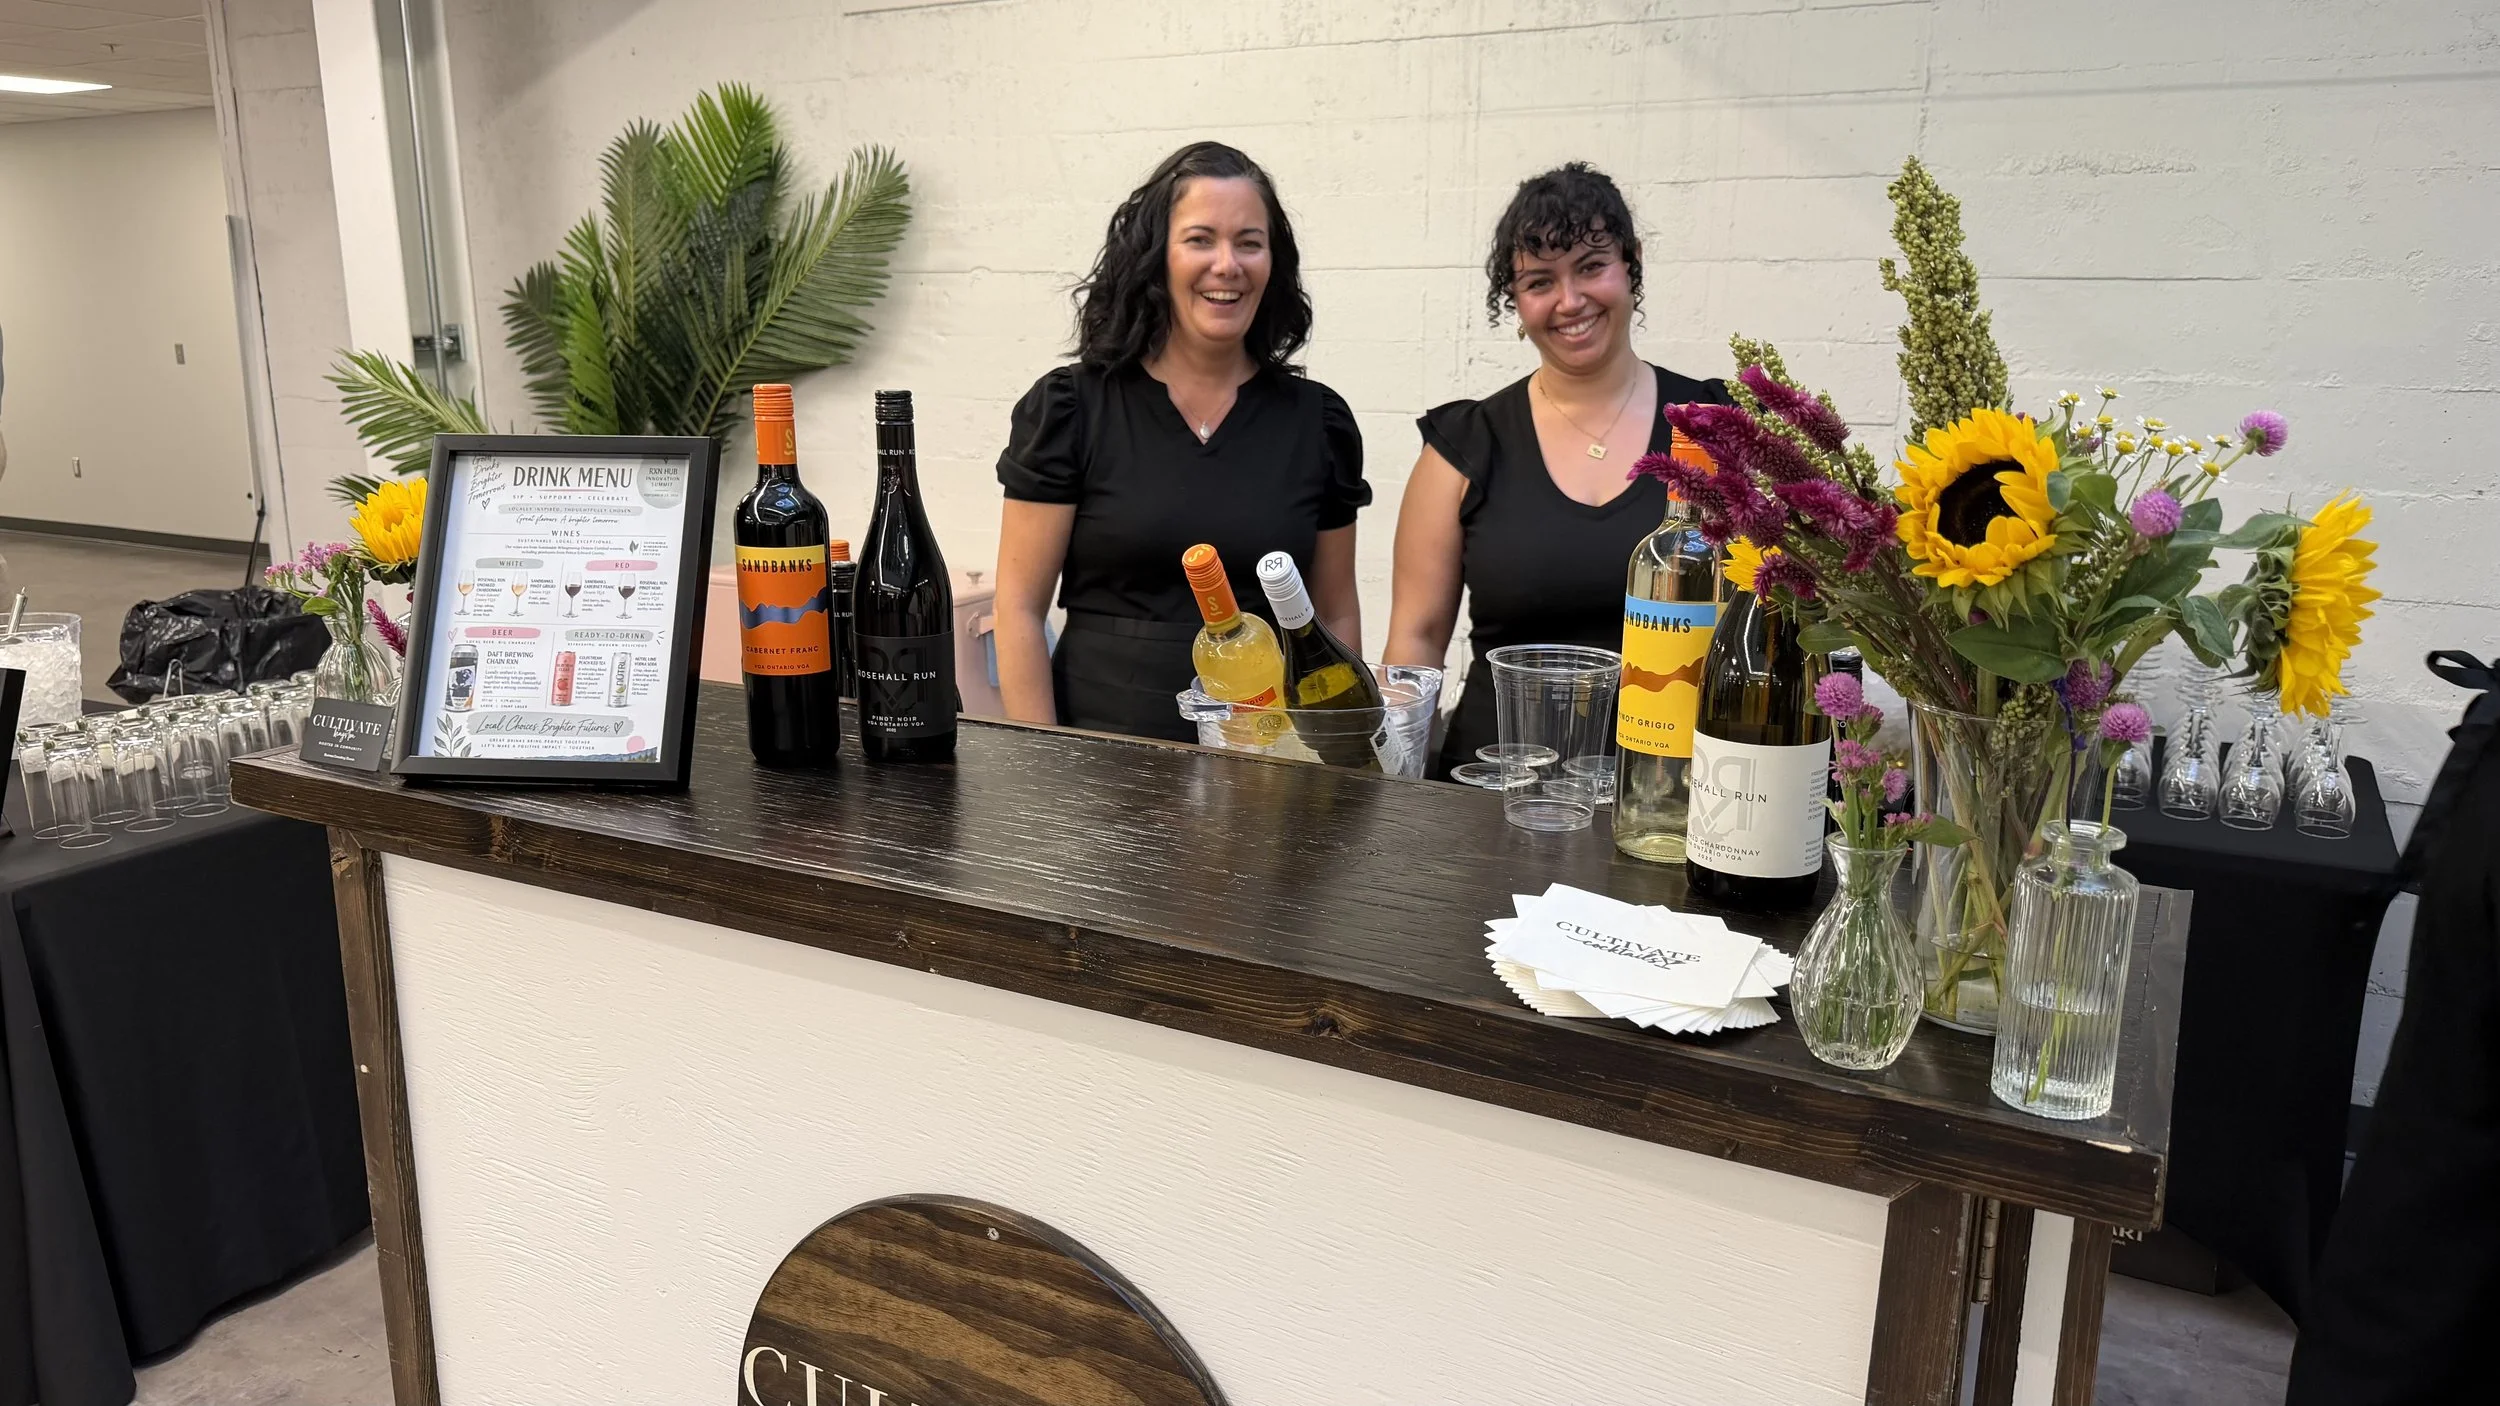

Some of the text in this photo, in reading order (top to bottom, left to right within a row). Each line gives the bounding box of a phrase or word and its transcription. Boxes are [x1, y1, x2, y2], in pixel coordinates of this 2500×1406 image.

[513, 466, 632, 488] DRINK MENU
[648, 467, 662, 475] RXN
[470, 472, 503, 492] Brighter
[742, 558, 812, 573] SANDBANKS
[574, 632, 646, 640] READY-TO-DRINK
[746, 646, 819, 654] CABERNET FRANC
[858, 670, 936, 681] ROSEHALL RUN
[312, 714, 382, 736] CULTIVATE
[476, 715, 506, 733] Local
[538, 718, 576, 736] Brighter
[1638, 718, 1675, 730] GRIGIO
[1626, 736, 1652, 746] ONTARIO
[1734, 791, 1767, 803] RUN
[1700, 839, 1760, 856] CHARDONNAY
[1556, 921, 1701, 962] CULTIVATE
